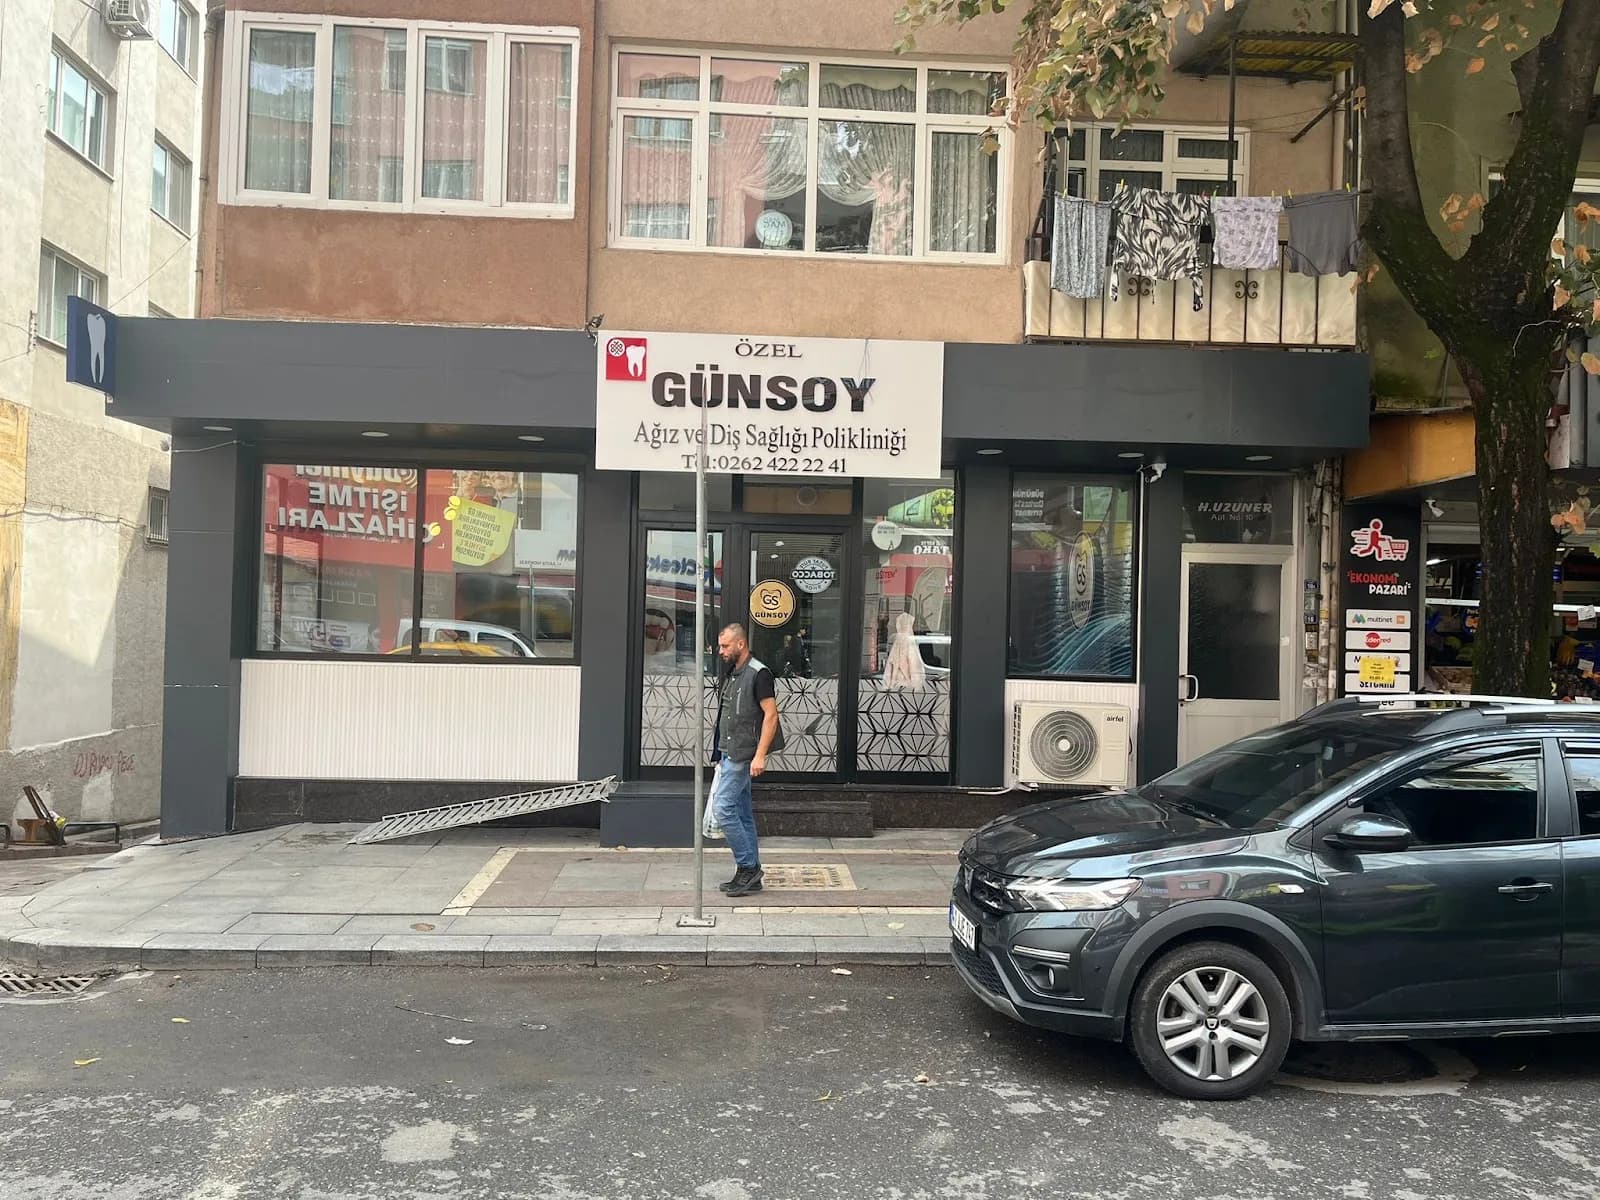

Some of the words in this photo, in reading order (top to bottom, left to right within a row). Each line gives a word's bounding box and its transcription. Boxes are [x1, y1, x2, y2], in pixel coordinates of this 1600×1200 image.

[735, 338, 802, 358] ÖZEL
[652, 363, 876, 412] GÜNSOY
[633, 420, 680, 449] Ağız
[683, 427, 705, 444] ve
[710, 423, 741, 451] Diş
[745, 423, 808, 453] Sağlığı
[811, 426, 907, 456] Polikliniği
[766, 457, 798, 472] 422
[802, 458, 824, 472] 22
[828, 458, 846, 473] 41
[1197, 502, 1273, 514] H.UZUNER
[1368, 584, 1408, 595] PAZARI
[755, 611, 789, 619] GÜNSOY
